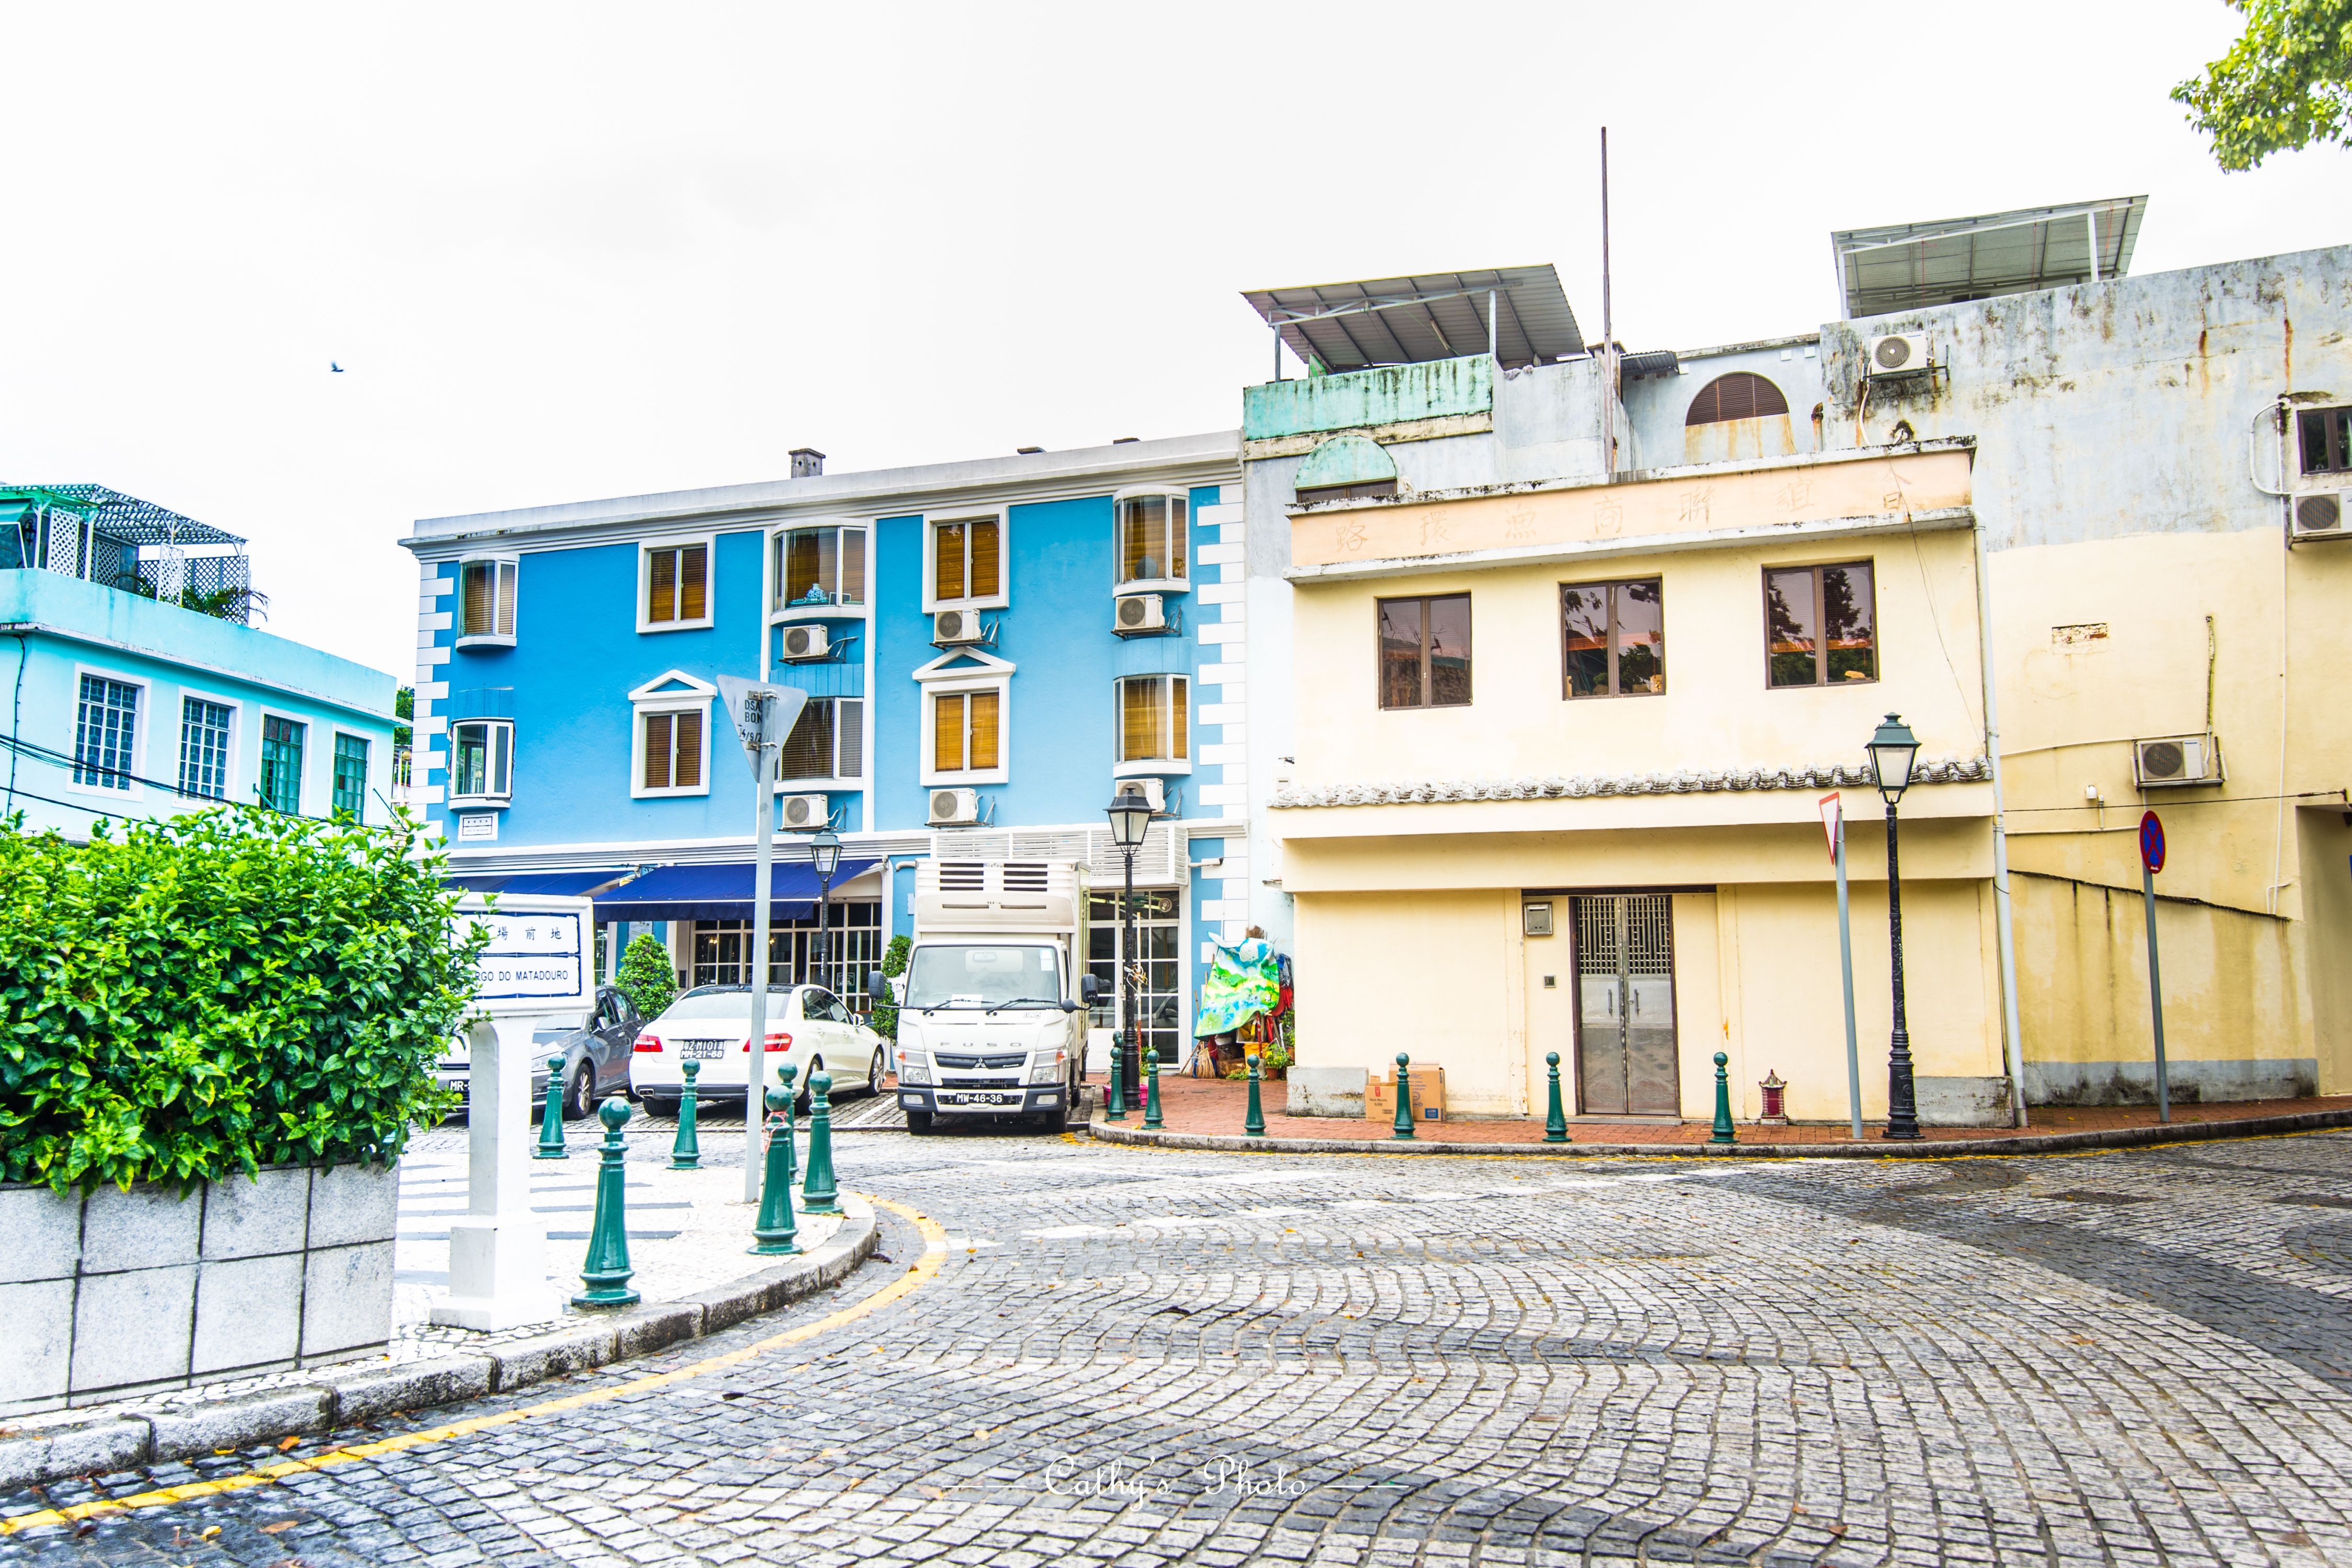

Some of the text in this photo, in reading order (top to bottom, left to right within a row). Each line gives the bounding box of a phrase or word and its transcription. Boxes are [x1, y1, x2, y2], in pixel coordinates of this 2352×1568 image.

[497, 926, 562, 941] 場前地
[499, 971, 511, 981] DO
[515, 970, 569, 981] MATADOURO
[681, 1050, 723, 1058] MM-21-68
[956, 1093, 1003, 1103] MW-46-36
